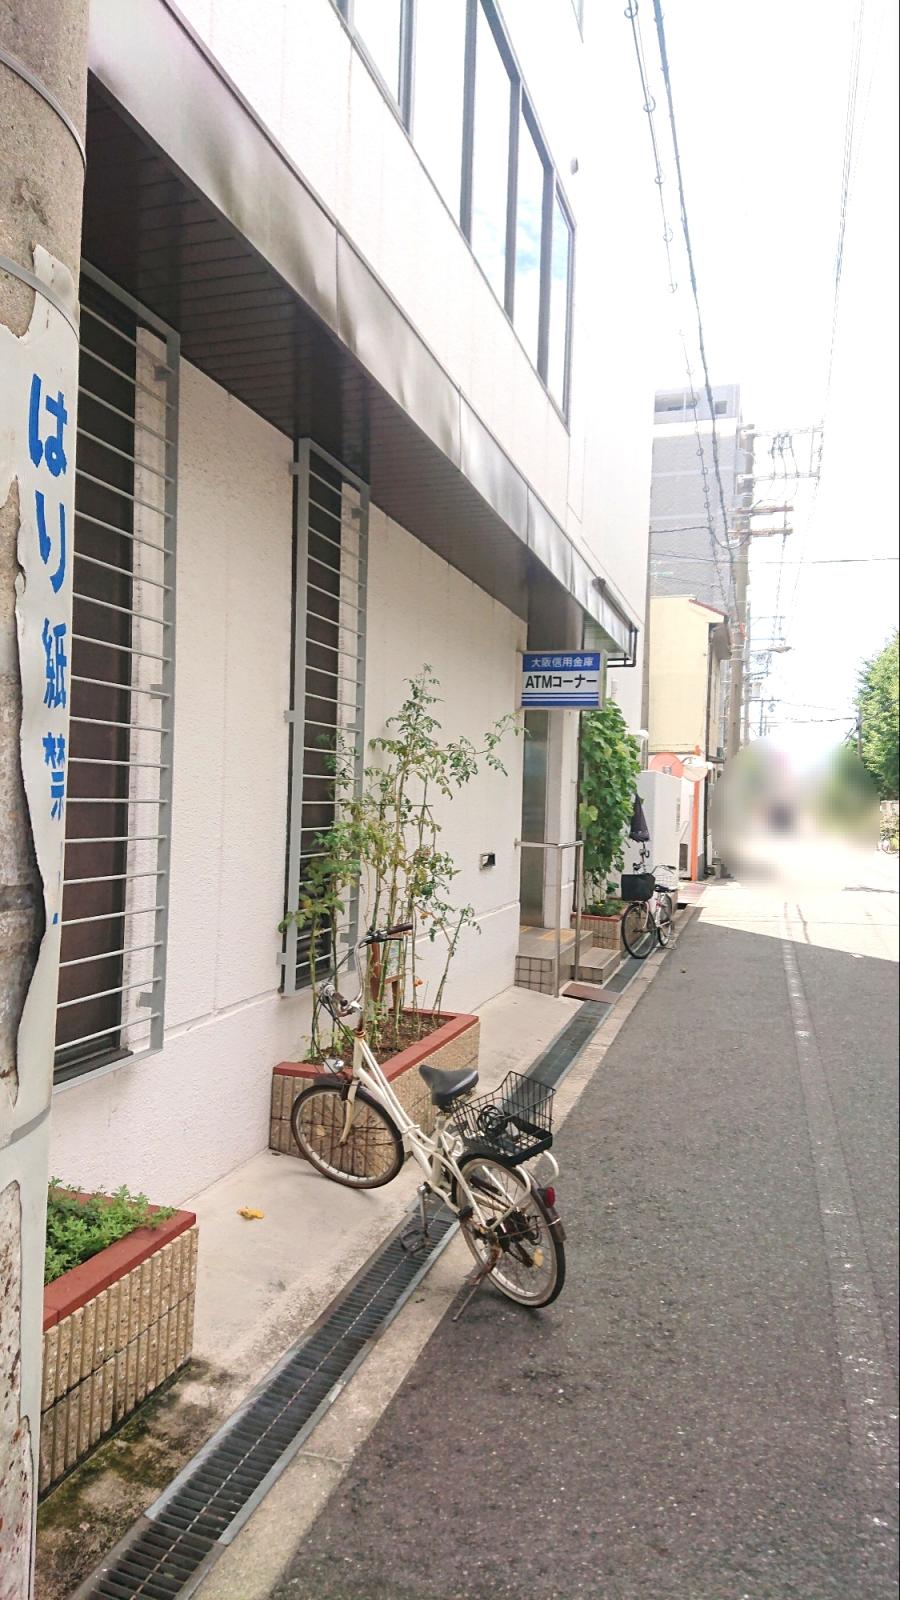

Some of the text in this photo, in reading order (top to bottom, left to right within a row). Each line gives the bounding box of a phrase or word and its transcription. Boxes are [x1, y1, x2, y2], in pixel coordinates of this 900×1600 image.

[531, 656, 594, 668] 大阪信用金庫
[525, 674, 597, 688] ATMコーナー
